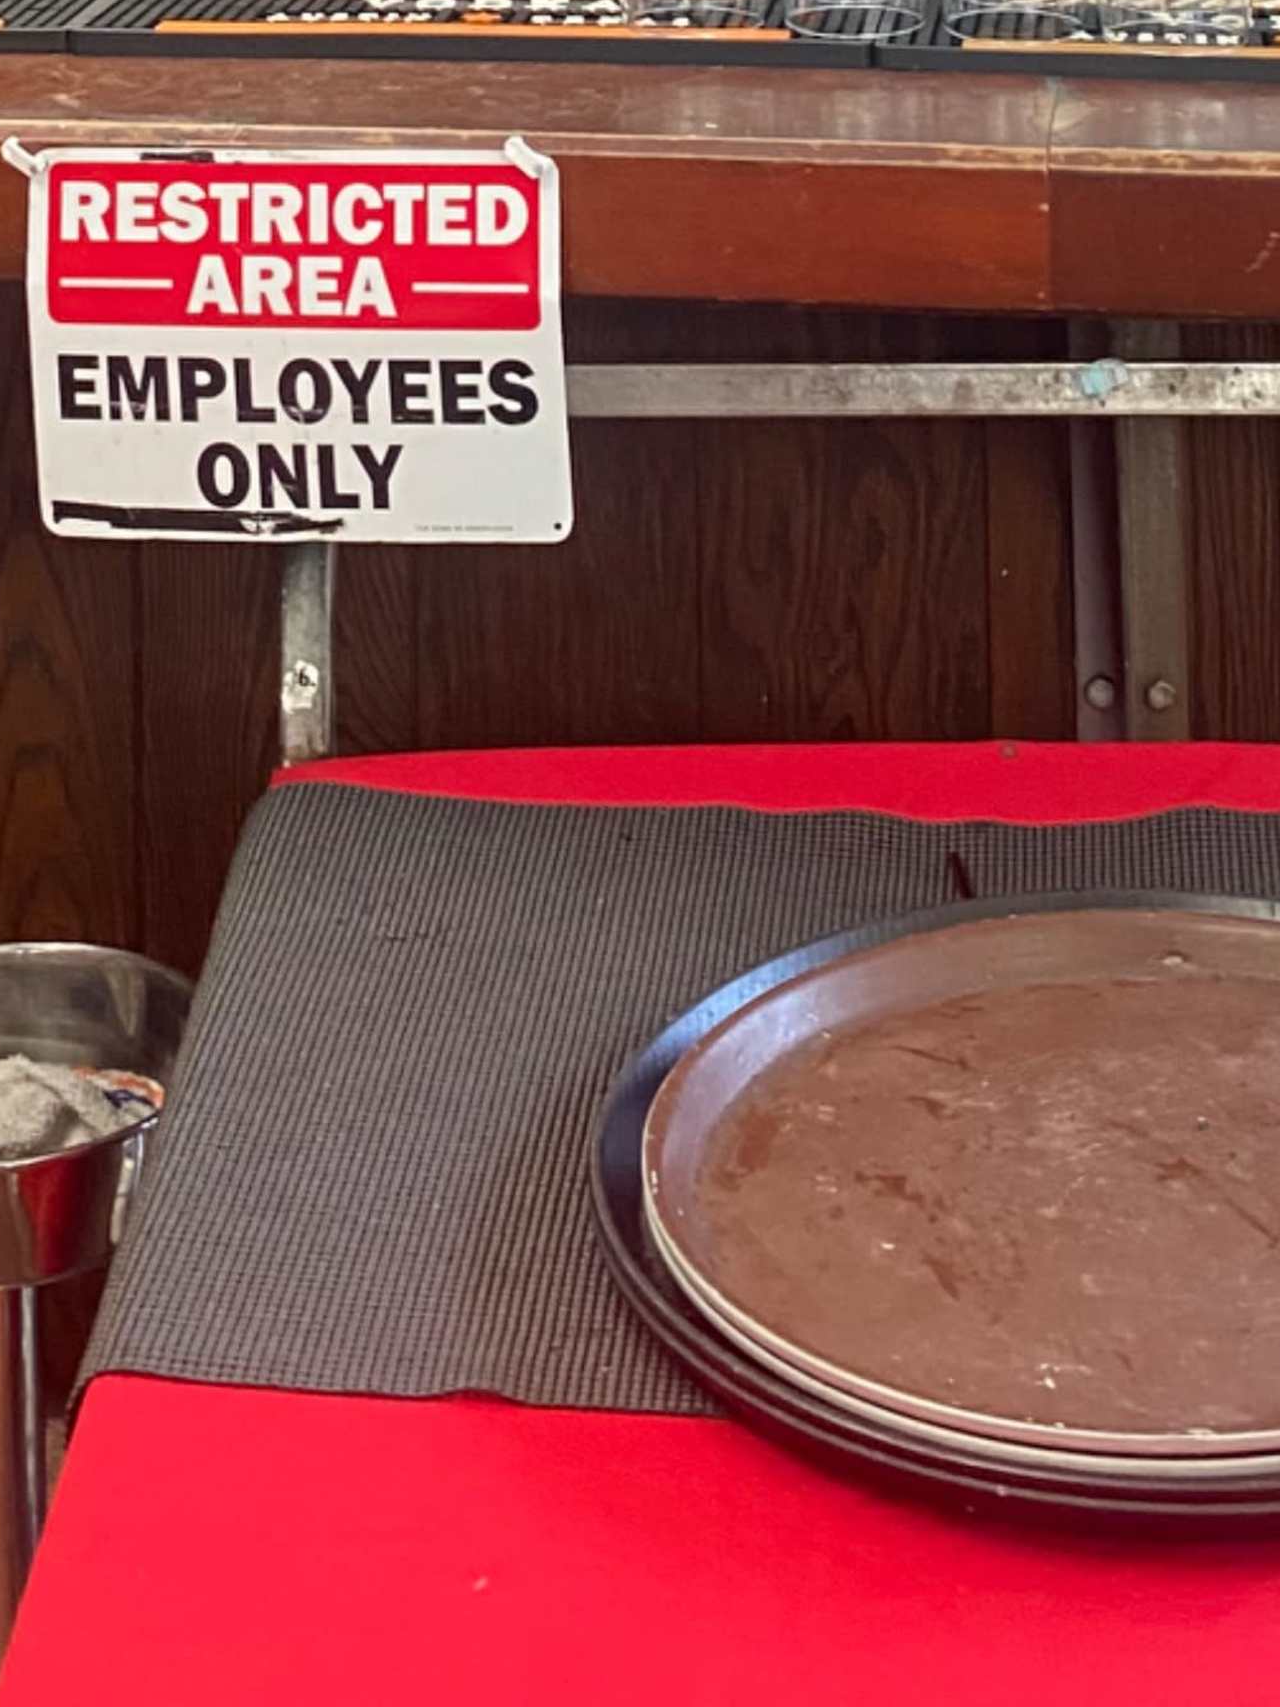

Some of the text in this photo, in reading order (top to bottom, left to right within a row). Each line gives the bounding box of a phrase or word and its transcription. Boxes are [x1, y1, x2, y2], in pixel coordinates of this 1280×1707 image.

[59, 181, 529, 246] RESTRICTED
[187, 255, 398, 318] AREA
[56, 353, 539, 425] EMPLOYEES
[196, 443, 403, 510] ONLY
